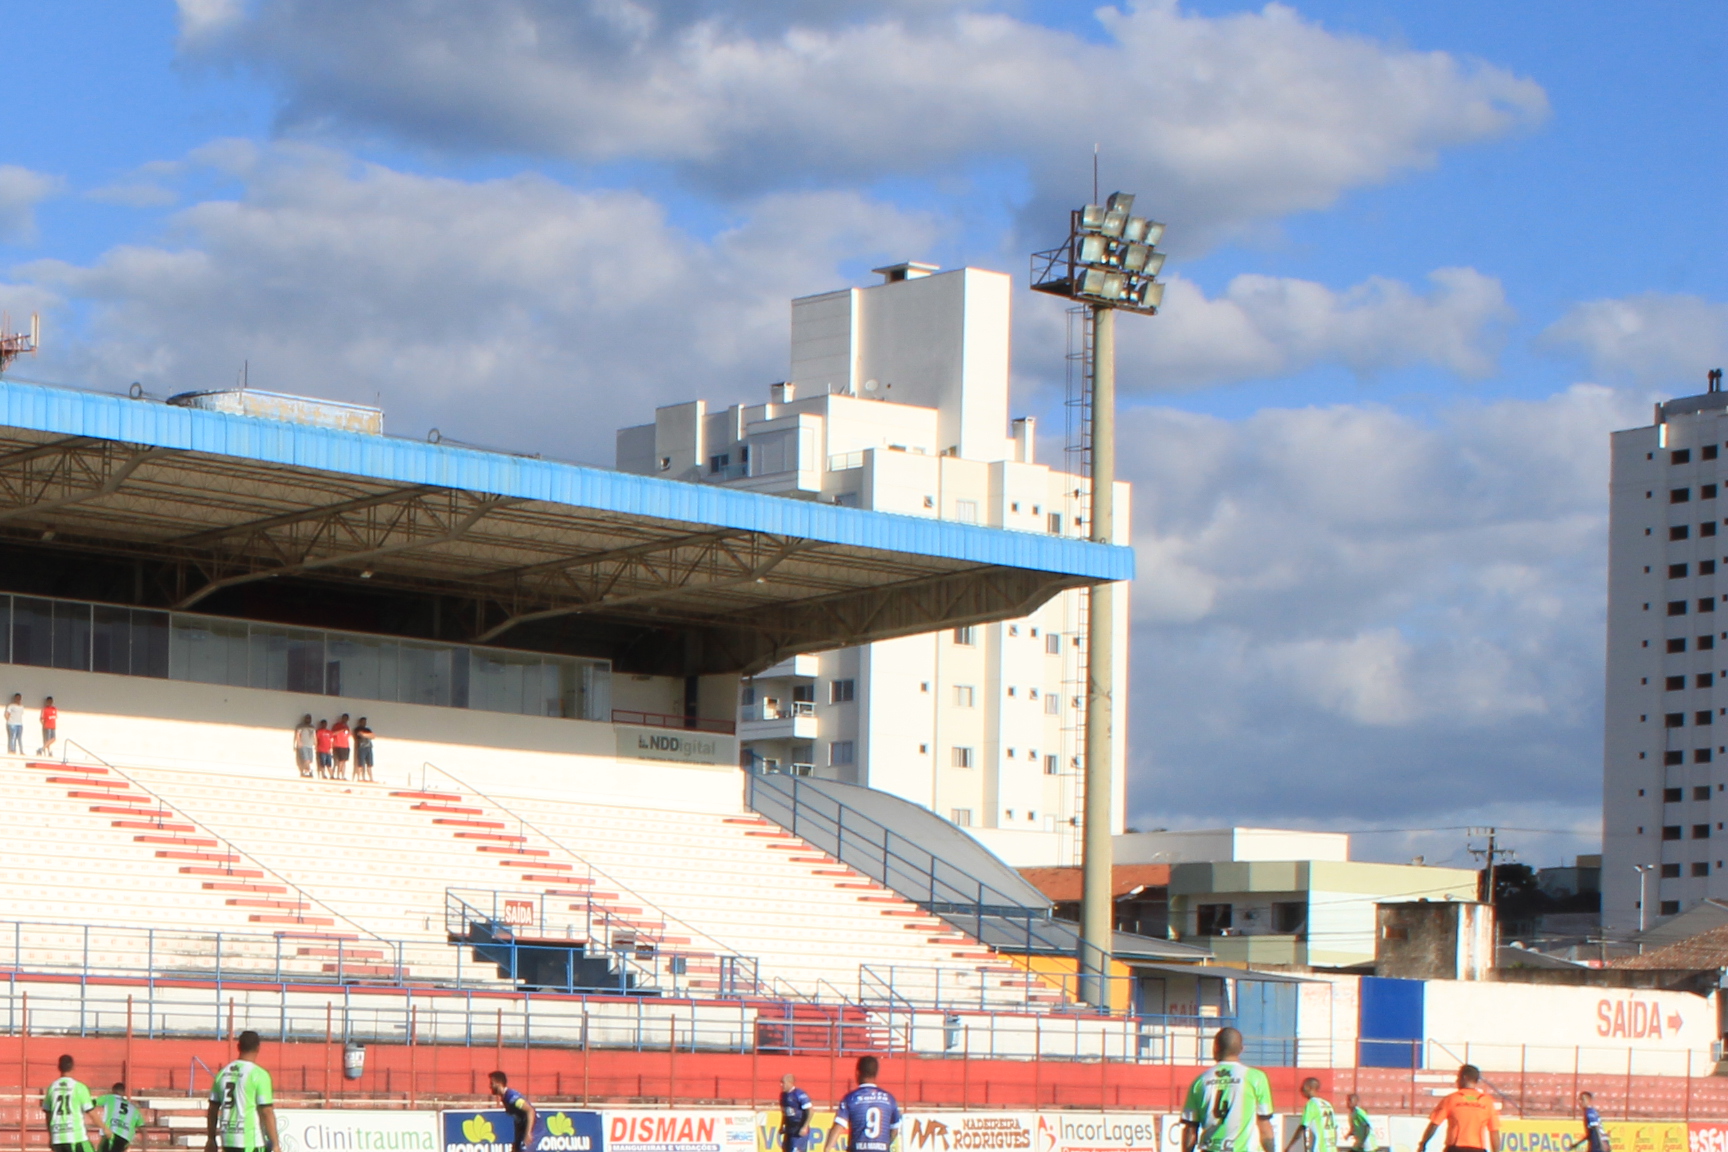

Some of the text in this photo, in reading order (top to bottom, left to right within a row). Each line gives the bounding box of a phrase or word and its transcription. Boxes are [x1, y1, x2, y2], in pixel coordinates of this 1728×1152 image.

[650, 735, 715, 756] NDDigital
[505, 903, 532, 924] SAÍDA
[1597, 992, 1662, 1039] SAÍDA
[56, 1095, 71, 1115] 21
[224, 1082, 236, 1109] 3
[1213, 1090, 1229, 1119] 4
[119, 1103, 128, 1115] 5
[610, 1117, 715, 1142] DISMAN
[864, 1107, 880, 1139] 9
[962, 1118, 1020, 1129] MADEIREIRA
[1060, 1116, 1152, 1146] IncorLages
[304, 1125, 434, 1150] Clinitrauma
[676, 1143, 717, 1151] VEDAÇÕES
[953, 1129, 1030, 1149] RODRIGUES
